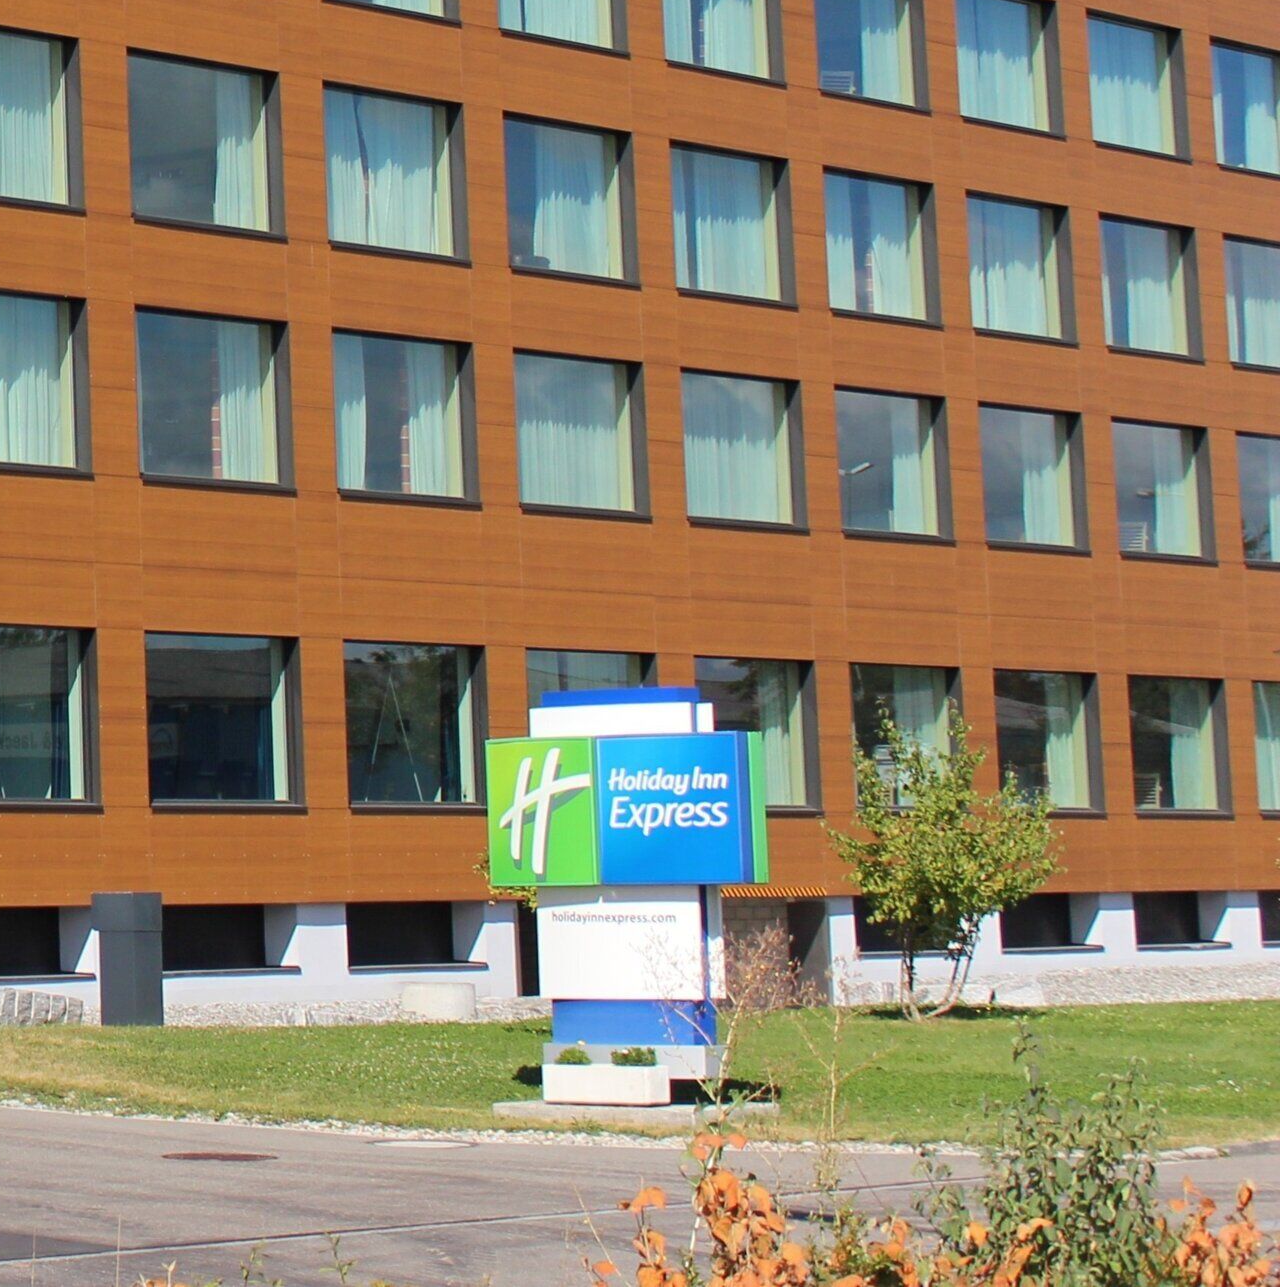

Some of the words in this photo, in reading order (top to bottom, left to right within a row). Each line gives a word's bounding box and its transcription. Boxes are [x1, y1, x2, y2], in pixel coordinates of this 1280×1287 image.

[608, 767, 690, 795] Holiday
[692, 766, 727, 789] Inn
[609, 796, 728, 836] Express
[551, 912, 677, 924] holidayinnexpress.com
